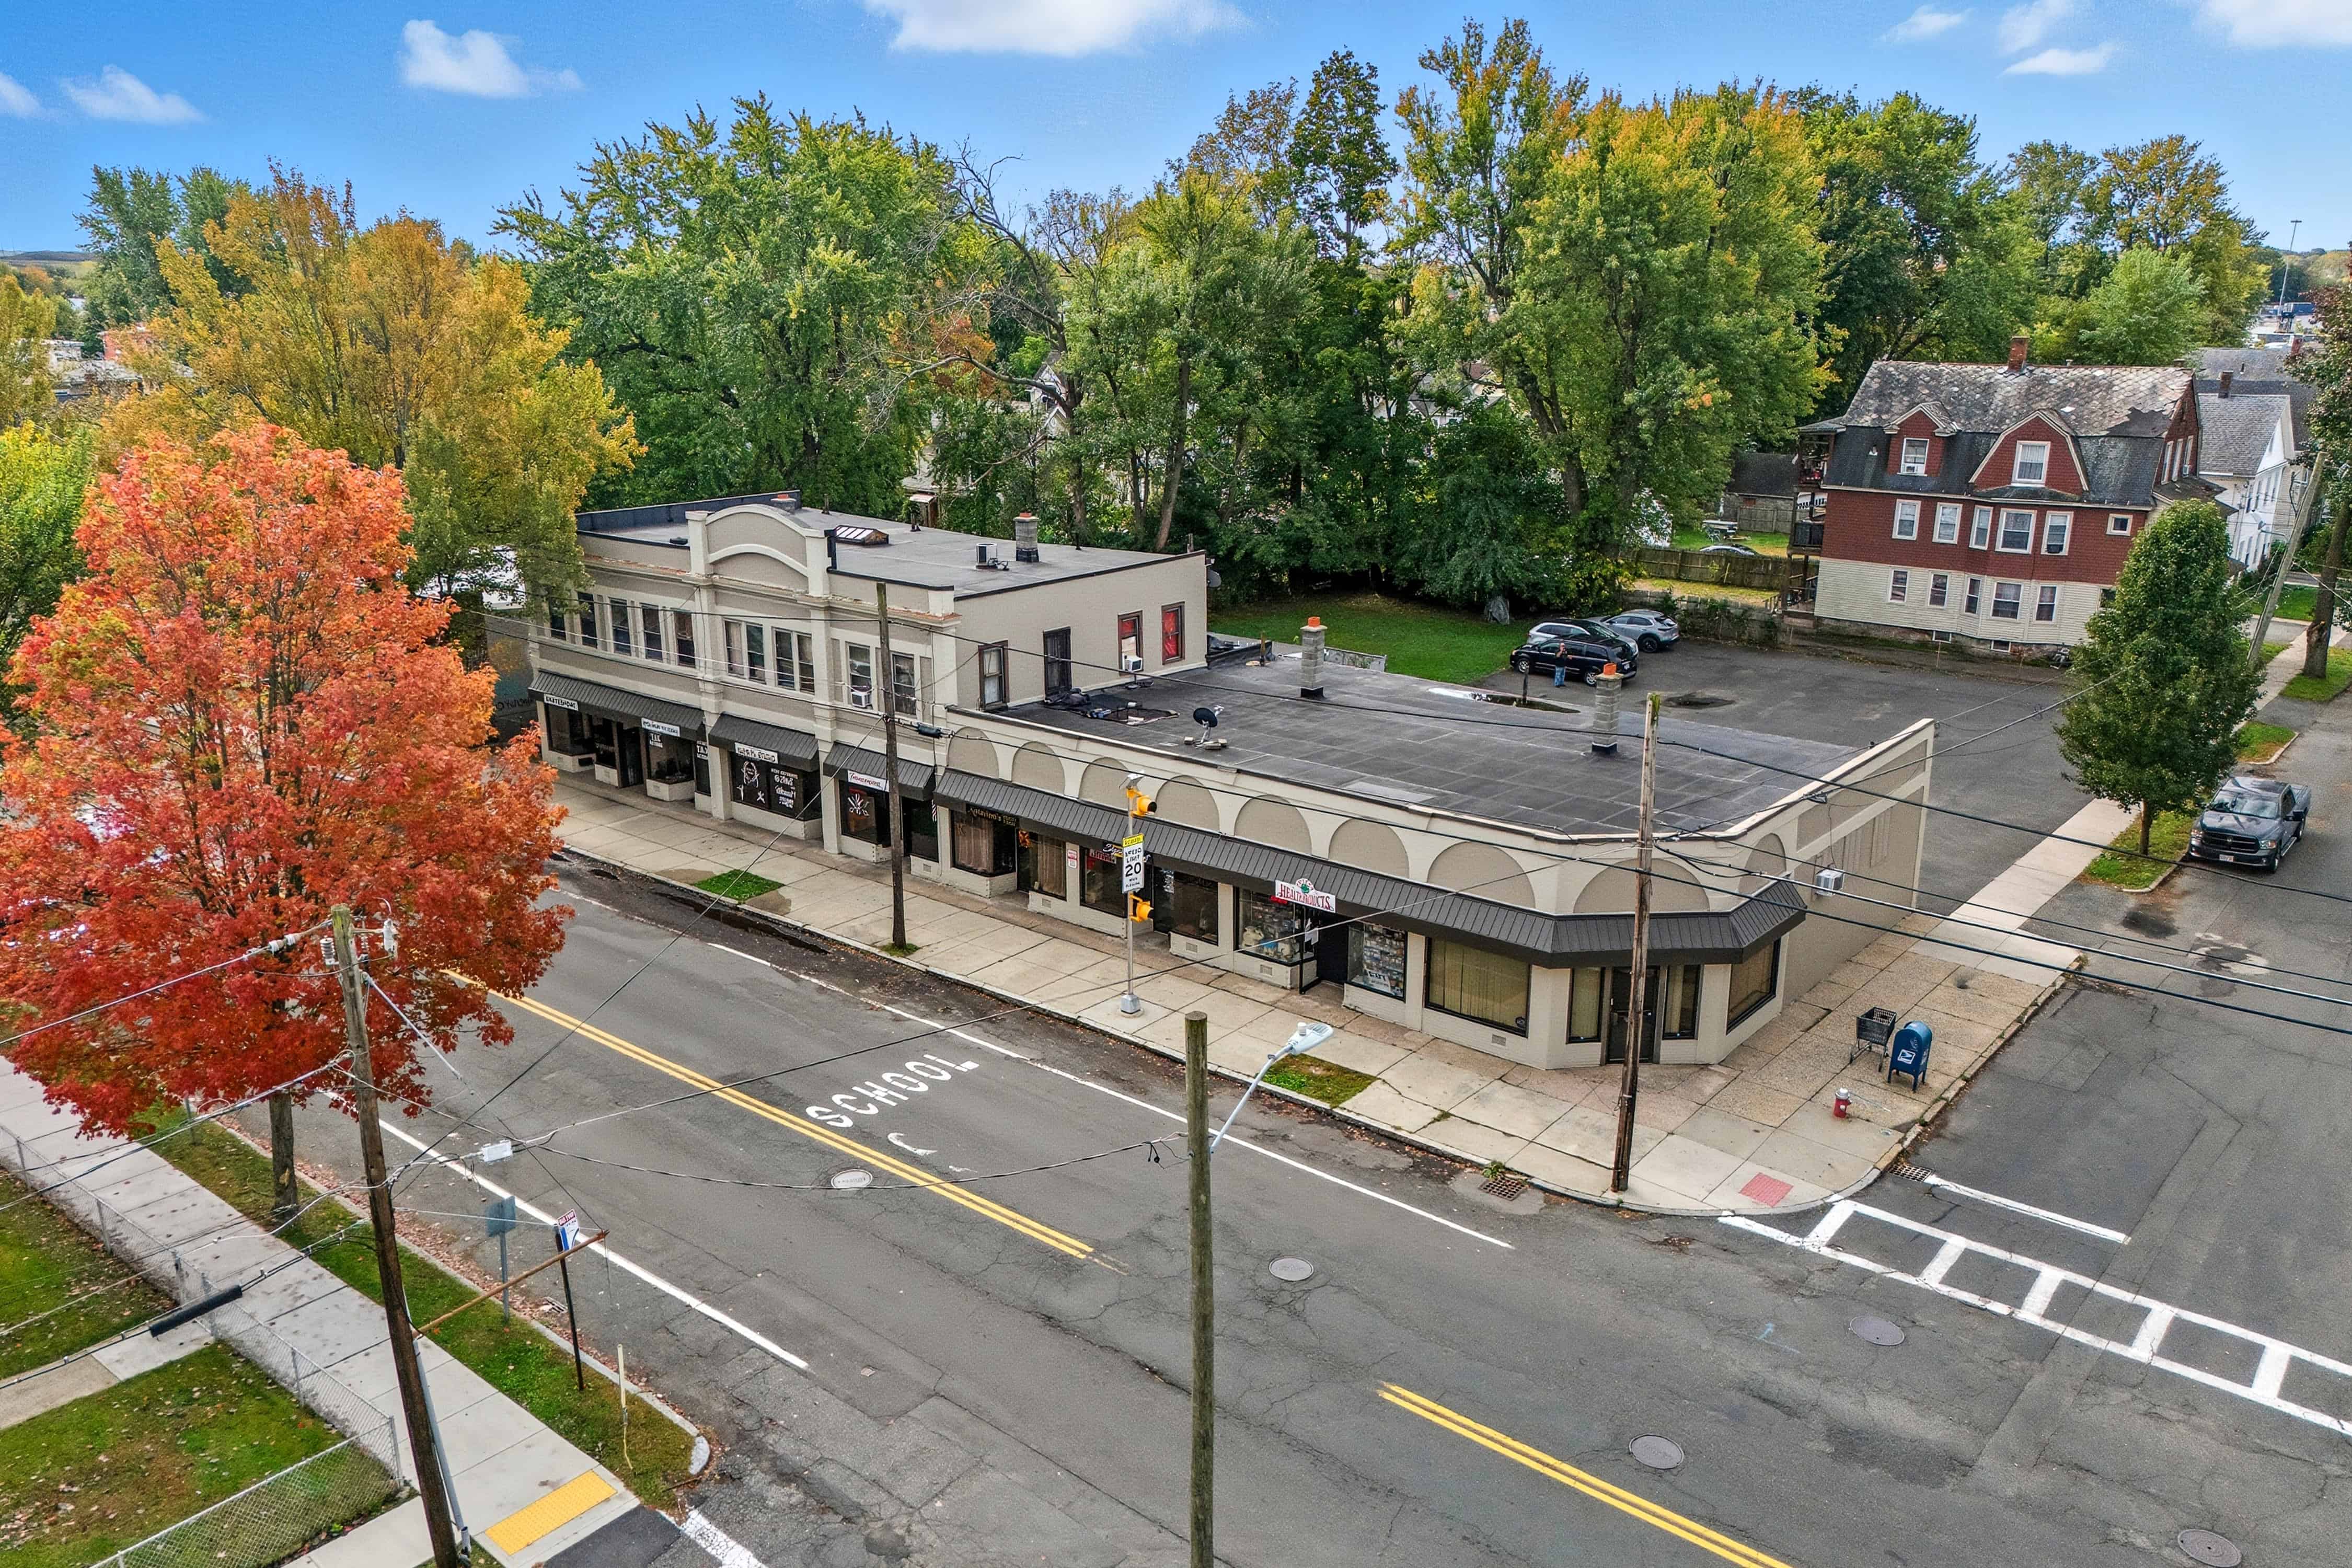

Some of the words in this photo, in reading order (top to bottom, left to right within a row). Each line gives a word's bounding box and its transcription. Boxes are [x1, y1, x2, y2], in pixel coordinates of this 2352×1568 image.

[1125, 847, 1142, 857] SPEED
[1126, 855, 1139, 863] LIMIT
[1125, 862, 1142, 877] 20
[805, 1054, 979, 1128] SCHOOL
